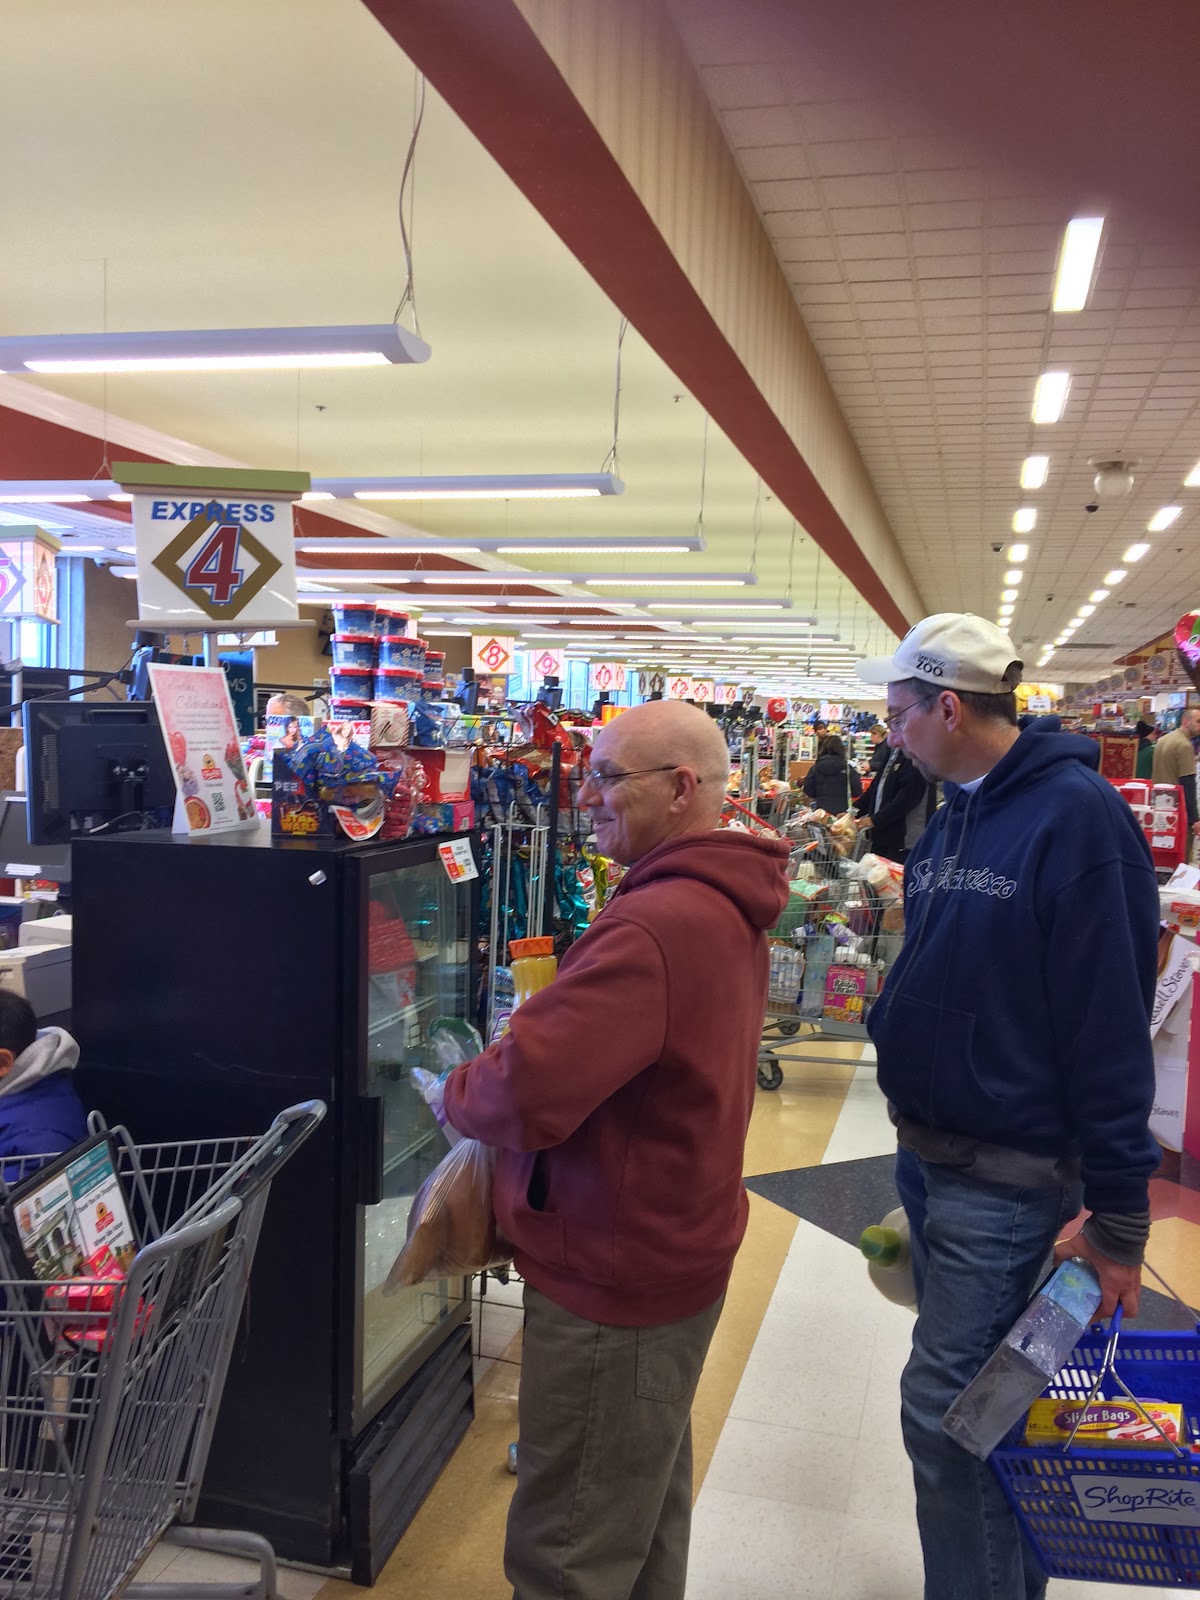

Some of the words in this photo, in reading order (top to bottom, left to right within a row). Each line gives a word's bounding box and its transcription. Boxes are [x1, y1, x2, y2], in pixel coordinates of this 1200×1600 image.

[151, 501, 275, 522] EXPRESS
[185, 523, 244, 604] 4
[485, 644, 501, 668] 8
[541, 655, 553, 675] 9
[596, 668, 612, 686] 10
[672, 681, 688, 695] 12
[273, 781, 299, 792] PEZ
[280, 820, 319, 832] WARS
[286, 813, 315, 823] STAR
[834, 979, 859, 991] Raisin
[1101, 1409, 1131, 1424] Bags
[1085, 1485, 1196, 1512] ShopRite
